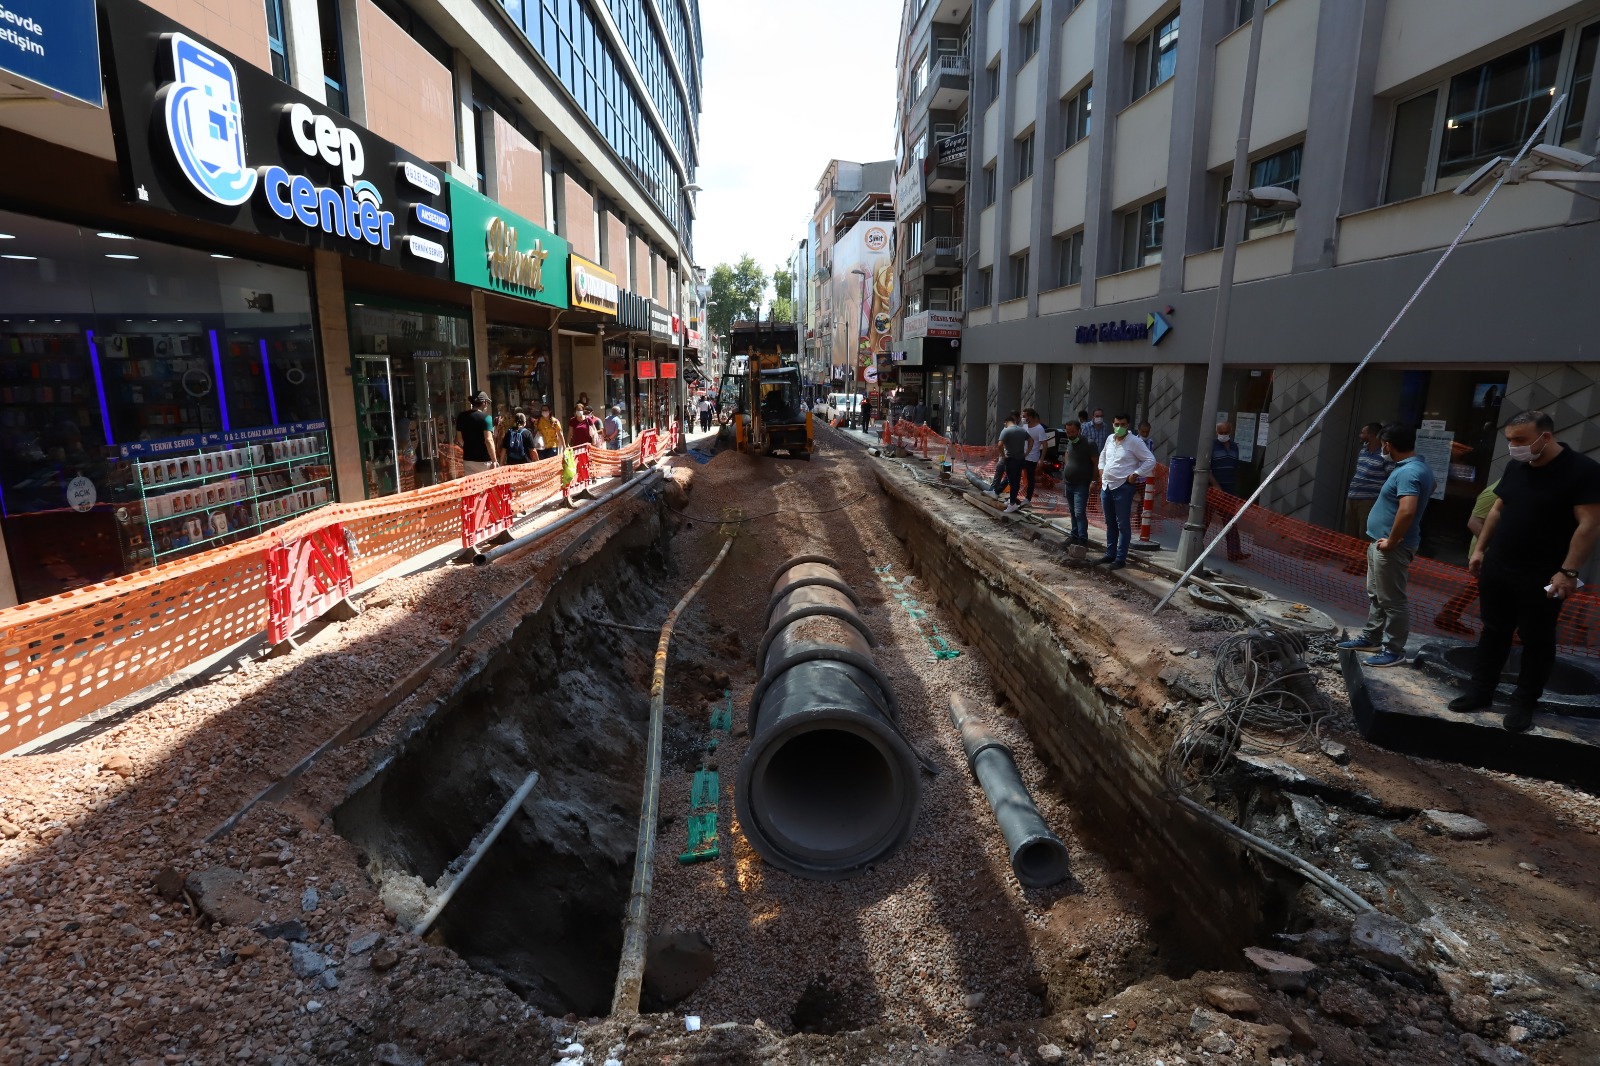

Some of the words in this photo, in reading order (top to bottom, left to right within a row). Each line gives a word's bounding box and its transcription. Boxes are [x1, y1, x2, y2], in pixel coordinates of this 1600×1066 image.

[290, 103, 365, 186] cep
[264, 165, 395, 250] center
[240, 431, 247, 439] EL
